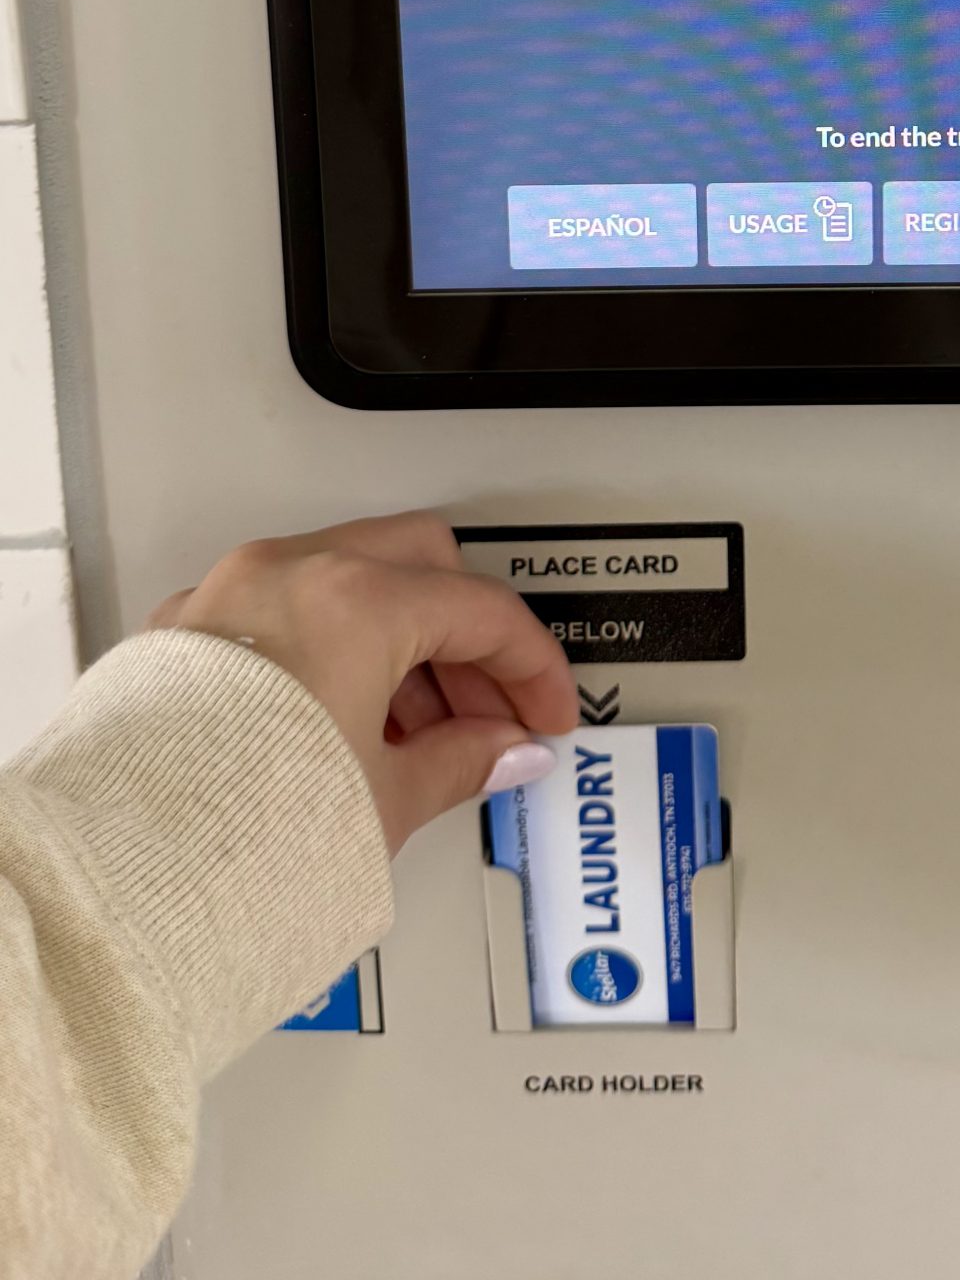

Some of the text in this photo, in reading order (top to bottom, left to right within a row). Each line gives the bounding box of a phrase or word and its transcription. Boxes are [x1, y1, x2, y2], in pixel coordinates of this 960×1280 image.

[816, 126, 844, 149] To
[850, 125, 895, 148] end
[901, 125, 941, 148] the
[547, 212, 657, 239] ESPAÑOL
[728, 213, 808, 236] USAGE
[511, 554, 679, 576] PLACE CARD
[551, 620, 645, 642] BELOW
[574, 745, 621, 934] LAUNDRY
[524, 1073, 704, 1093] CARD HOLDER
